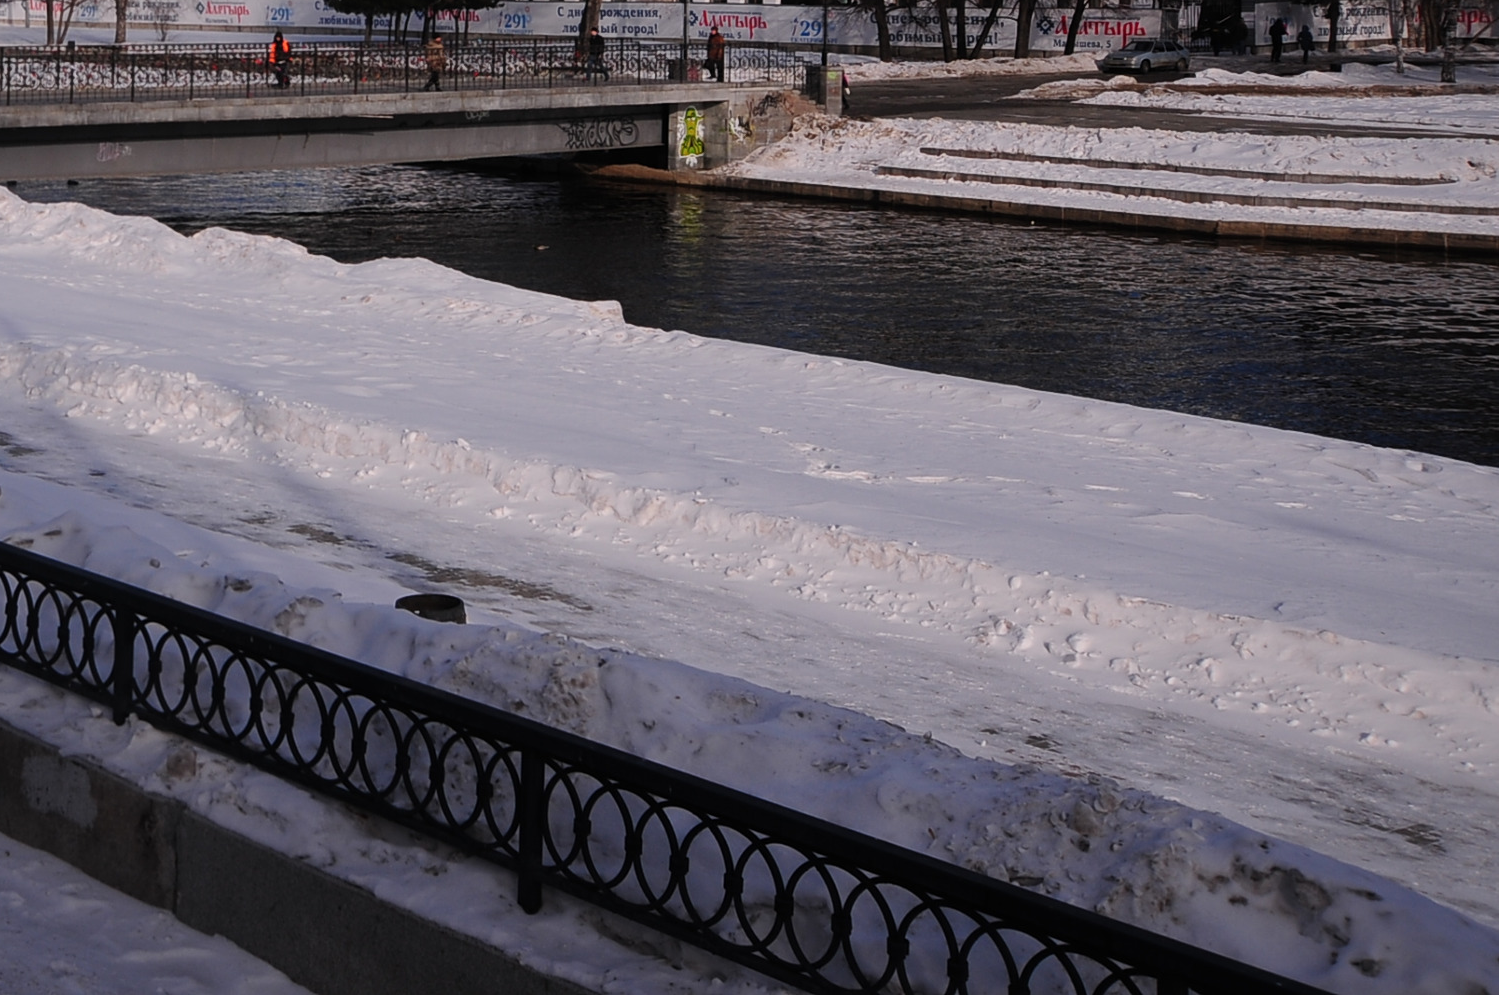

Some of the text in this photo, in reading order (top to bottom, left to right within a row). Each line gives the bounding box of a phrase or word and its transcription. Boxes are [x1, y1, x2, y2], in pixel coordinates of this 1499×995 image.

[557, 6, 565, 17] С
[600, 8, 662, 20] рождения,
[504, 14, 526, 28] 291
[622, 24, 658, 36] город!
